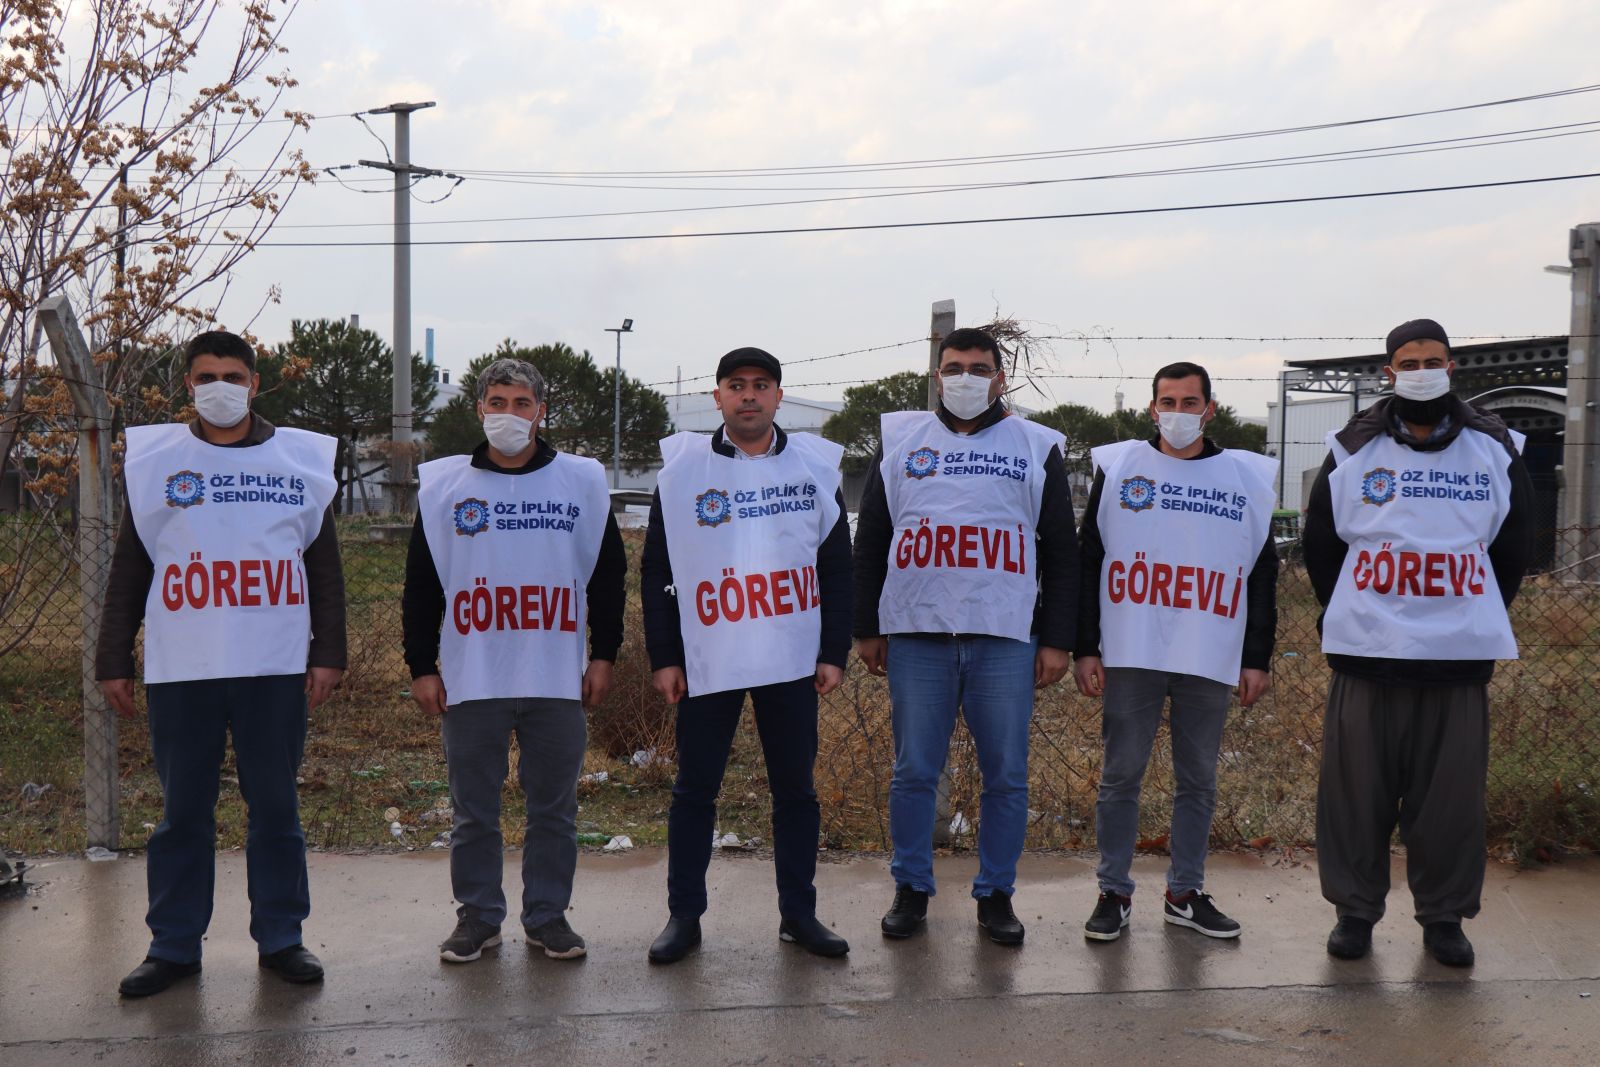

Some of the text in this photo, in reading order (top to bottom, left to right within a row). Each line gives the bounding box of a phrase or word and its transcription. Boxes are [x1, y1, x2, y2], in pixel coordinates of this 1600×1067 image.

[943, 451, 964, 463] ÖZ
[968, 450, 1008, 465] İPLİK
[1013, 457, 1028, 470] İŞ
[210, 471, 305, 493] ÖZ İPLİK İŞ
[943, 464, 1027, 483] SENDİKASI
[1400, 469, 1490, 487] ÖZ İPLİK İŞ
[212, 490, 304, 506] SENDİKASI
[734, 482, 817, 504] ÖZ İPLİK İŞ
[1160, 481, 1183, 496] ÖZ
[1187, 486, 1229, 503] İPLİK
[1231, 492, 1247, 509] İŞ
[1401, 486, 1490, 501] SENDİKASI
[493, 500, 580, 519] ÖZ İPLİK İŞ
[737, 499, 815, 519] SENDİKASI
[1160, 498, 1243, 522] SENDİKASI
[495, 518, 575, 533] SENDİKASI
[895, 517, 1026, 575] GÖREVLİ
[1107, 551, 1243, 619] GÖREVLİ
[695, 566, 821, 627] GÖREVL
